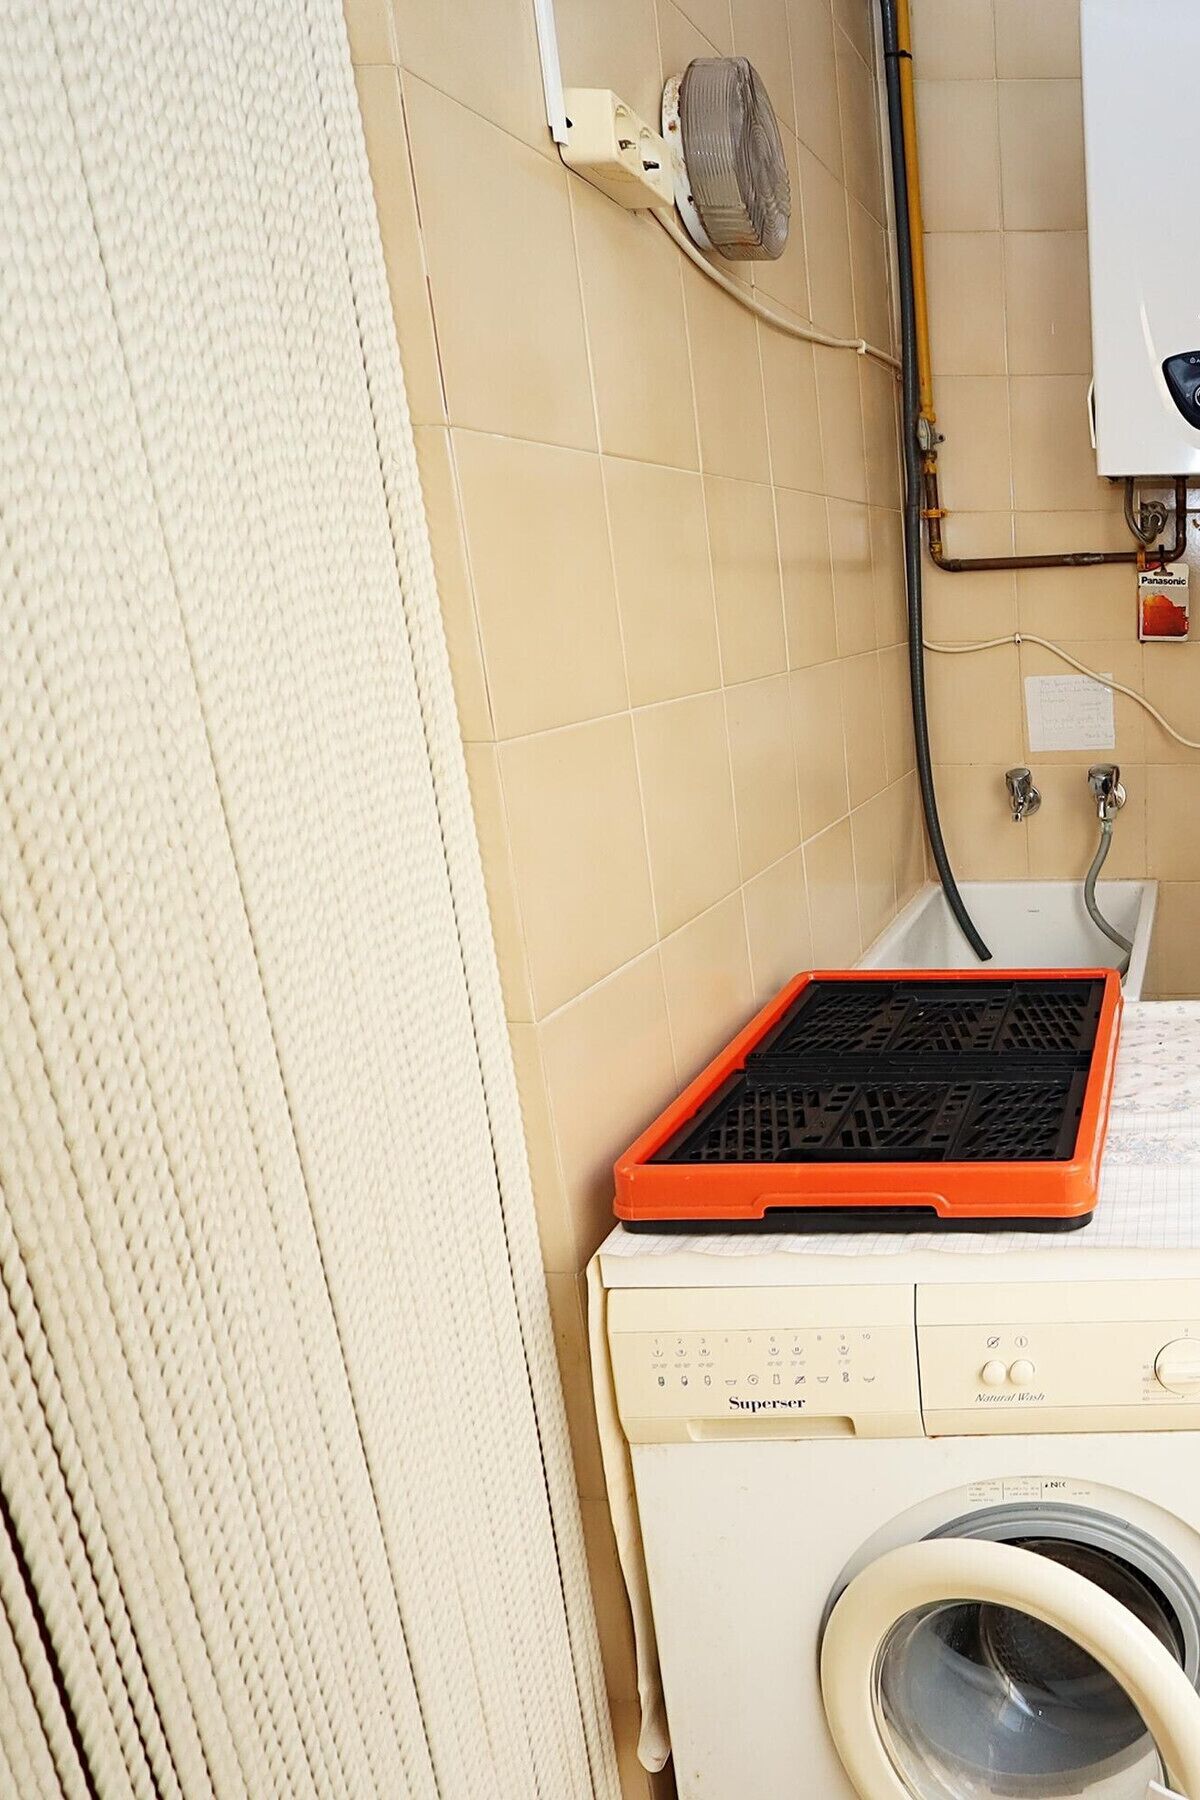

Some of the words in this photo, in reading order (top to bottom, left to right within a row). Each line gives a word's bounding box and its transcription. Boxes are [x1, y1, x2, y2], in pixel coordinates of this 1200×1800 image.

[1141, 576, 1186, 585] Panasonic
[975, 1393, 1016, 1402] Natural
[1017, 1392, 1045, 1401] Wash
[728, 1396, 806, 1413] Superser
